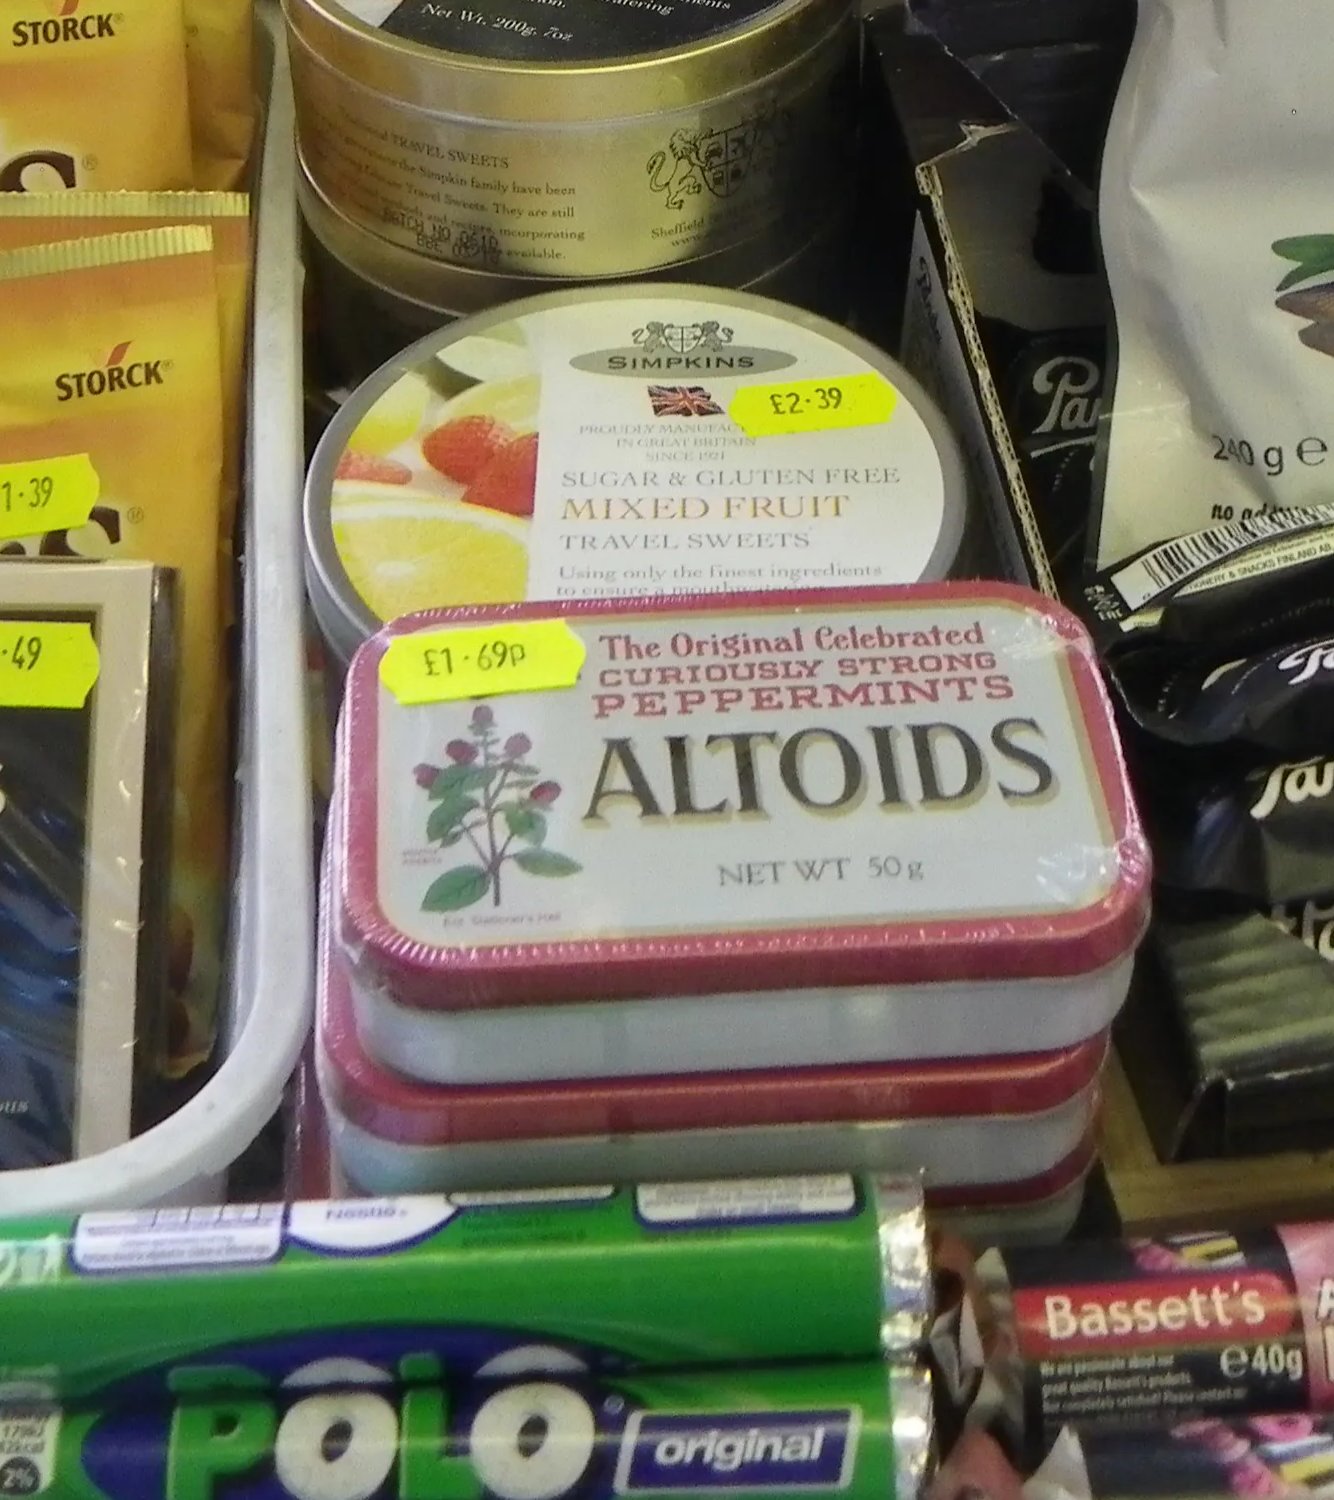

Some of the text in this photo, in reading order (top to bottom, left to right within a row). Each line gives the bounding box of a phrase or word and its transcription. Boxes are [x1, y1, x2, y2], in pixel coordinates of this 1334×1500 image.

[11, 11, 116, 48] STORCK
[54, 357, 164, 404] STORCK
[607, 353, 756, 373] SIMPKINS
[560, 466, 902, 489] SUGAR & GLUTEN FREE
[559, 494, 853, 522] MIXED FRUIT
[558, 530, 812, 551] TRAVEL SWEETS
[557, 561, 884, 586] Using only the finest ingredients
[600, 620, 986, 664] The Original Celebrated
[598, 649, 1000, 689] CURIOUSLY STRONG
[593, 674, 1017, 721] PEPPERMINTS
[581, 717, 1061, 828] ALTOIDS
[717, 860, 787, 888] NET
[793, 858, 852, 882] WT
[1043, 1280, 1269, 1344] Bassett's
[165, 1378, 597, 1500] POLO
[654, 1425, 824, 1475] original
